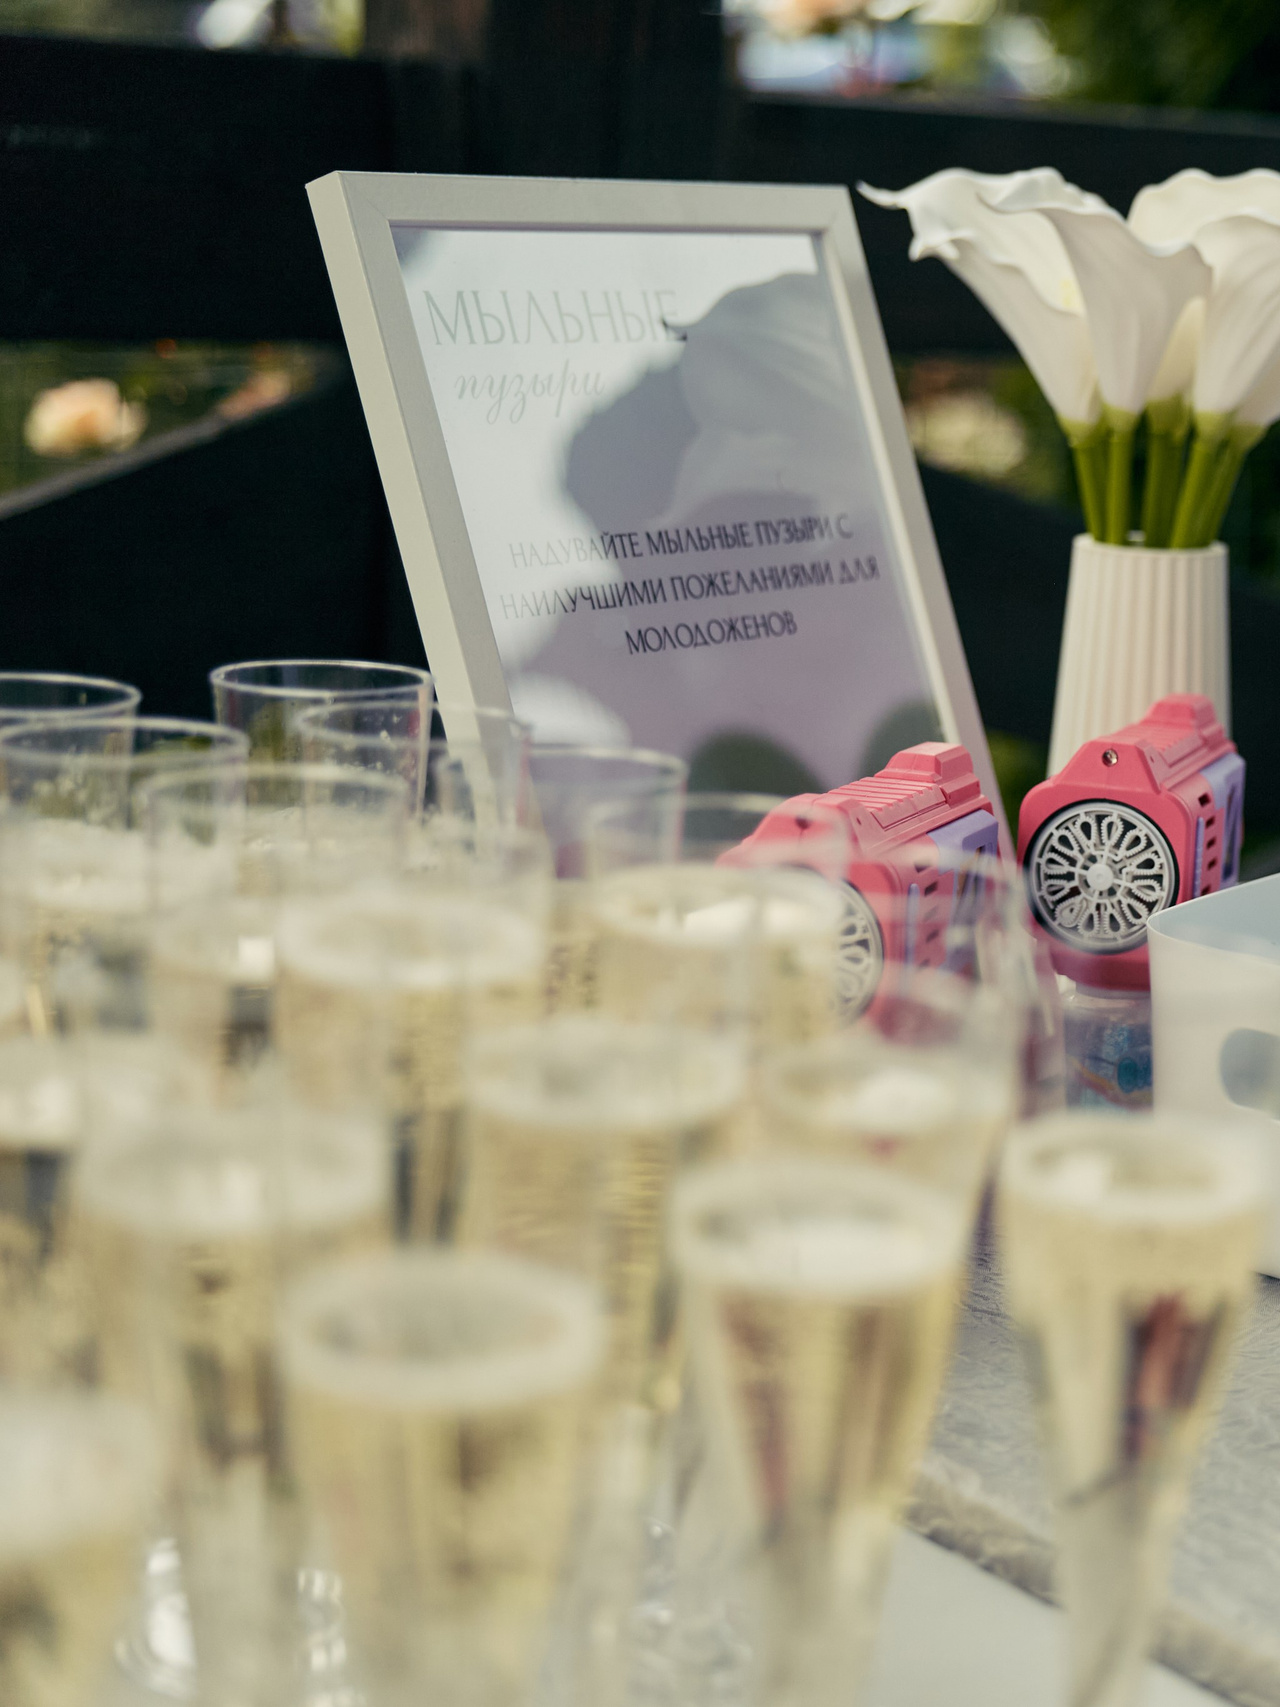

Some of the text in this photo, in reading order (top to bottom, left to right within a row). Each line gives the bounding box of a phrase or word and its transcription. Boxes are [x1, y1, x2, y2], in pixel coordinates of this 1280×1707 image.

[422, 289, 687, 346] МЫЛЬНЫЕ
[455, 358, 606, 425] пузыри
[508, 512, 854, 568] НАДУВАЙТЕ МЫЛЬНЫЕ ПУЗЫРИ С
[500, 554, 881, 620] НАИЛУЧШИМИ ПОЖЕЛАНИЯМИ ДЛЯ
[624, 609, 798, 656] МОЛОДОЖЕНОВ
